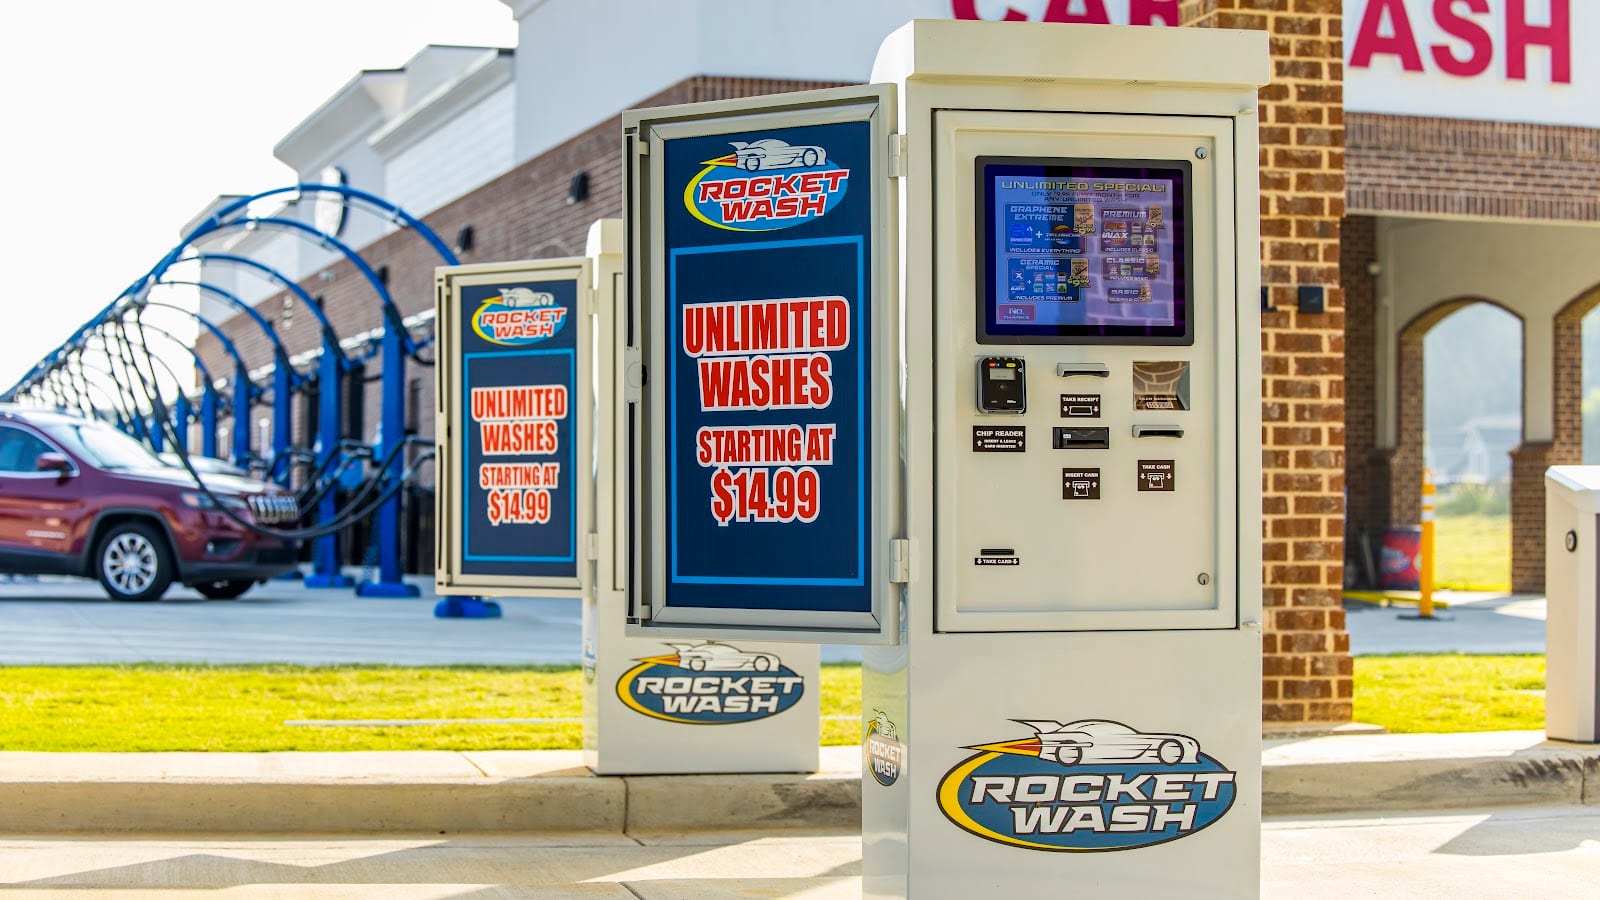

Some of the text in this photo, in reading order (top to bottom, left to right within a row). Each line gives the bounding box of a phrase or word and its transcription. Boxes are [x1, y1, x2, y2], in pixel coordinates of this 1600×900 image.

[699, 169, 849, 203] ROCKET
[1002, 182, 1166, 192] UNLIMITED SPECIAL!
[721, 194, 826, 223] WASH
[1011, 206, 1068, 214] GRAPHENE
[1104, 210, 1146, 218] PREMIUM
[481, 308, 567, 326] ROCKET
[494, 323, 554, 340] WASH
[684, 298, 848, 355] UNLIMITED
[699, 357, 830, 408] WASHES
[473, 388, 566, 418] UNLIMITED
[482, 422, 556, 452] WASHES
[699, 427, 833, 464] STARTING AT
[481, 465, 557, 486] STARTING AT
[489, 491, 549, 522] $14.99
[713, 468, 817, 523] $14.99
[636, 676, 804, 695] ROCKET
[662, 695, 780, 713] WASH
[869, 739, 902, 761] ROCKET
[874, 758, 897, 779] WASH
[970, 772, 1236, 804] ROCKET
[1010, 804, 1197, 834] WASH
